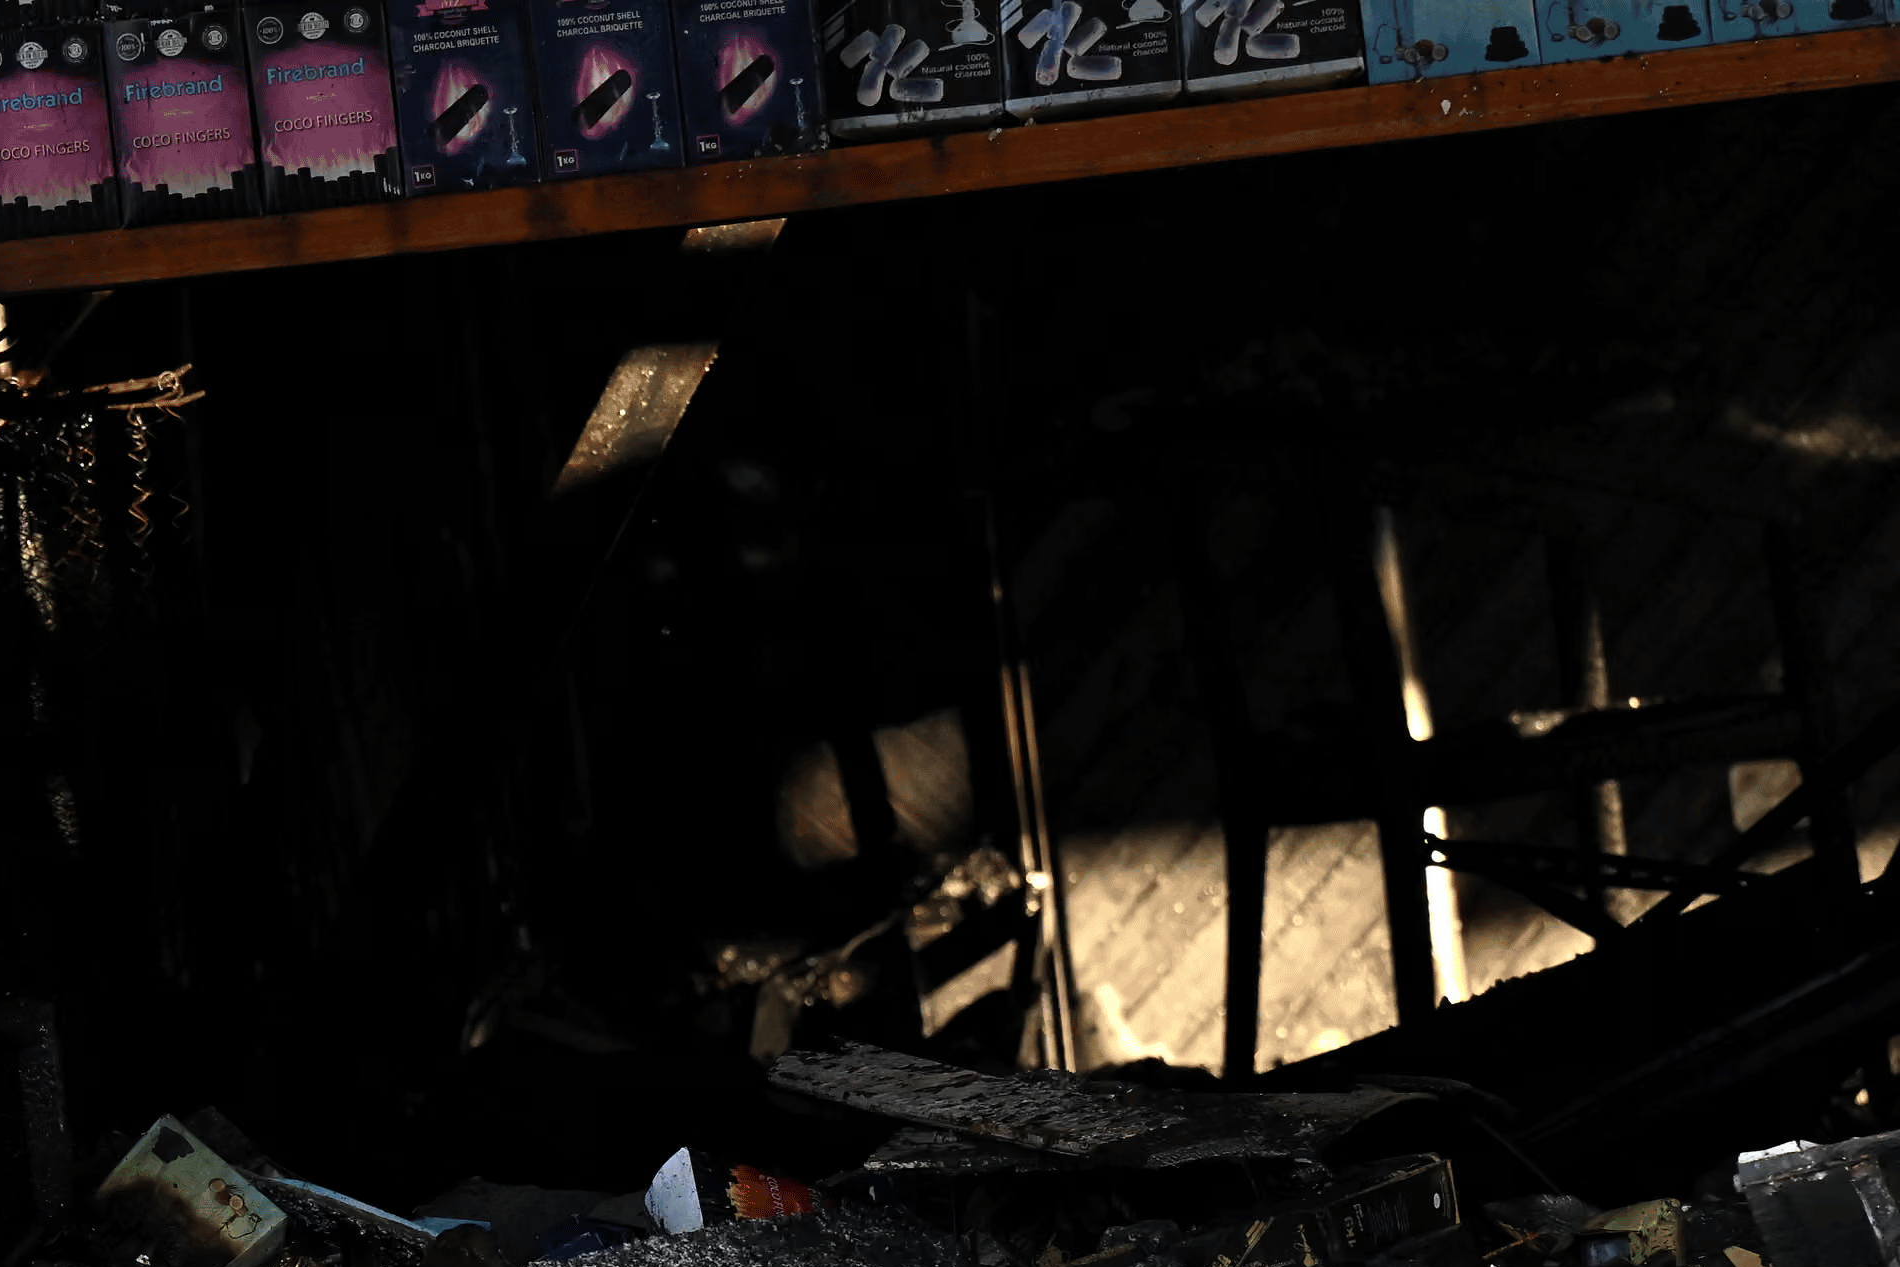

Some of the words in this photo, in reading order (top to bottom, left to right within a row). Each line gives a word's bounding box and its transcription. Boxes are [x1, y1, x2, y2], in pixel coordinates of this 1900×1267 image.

[557, 17, 576, 27] 100%
[577, 12, 615, 25] COCONUT
[616, 10, 641, 21] SHELL
[699, 11, 741, 23] CHARCOAL
[743, 5, 786, 18] BRIQUETTE
[413, 32, 433, 43] 100%
[434, 27, 472, 40] COCONUT
[473, 25, 498, 35] SHELL
[556, 26, 600, 38] CHARCOAL
[600, 20, 643, 33] BRIQUETTE
[413, 40, 456, 53] CHARCOAL
[456, 35, 500, 48] BRIQUETTE
[266, 57, 365, 85] Firebrand
[124, 74, 224, 103] Firebrand
[274, 116, 313, 133] COCO
[315, 110, 373, 129] FINGERS
[133, 132, 172, 149] COCO
[174, 127, 231, 145] FINGERS
[34, 139, 90, 157] FINGERS
